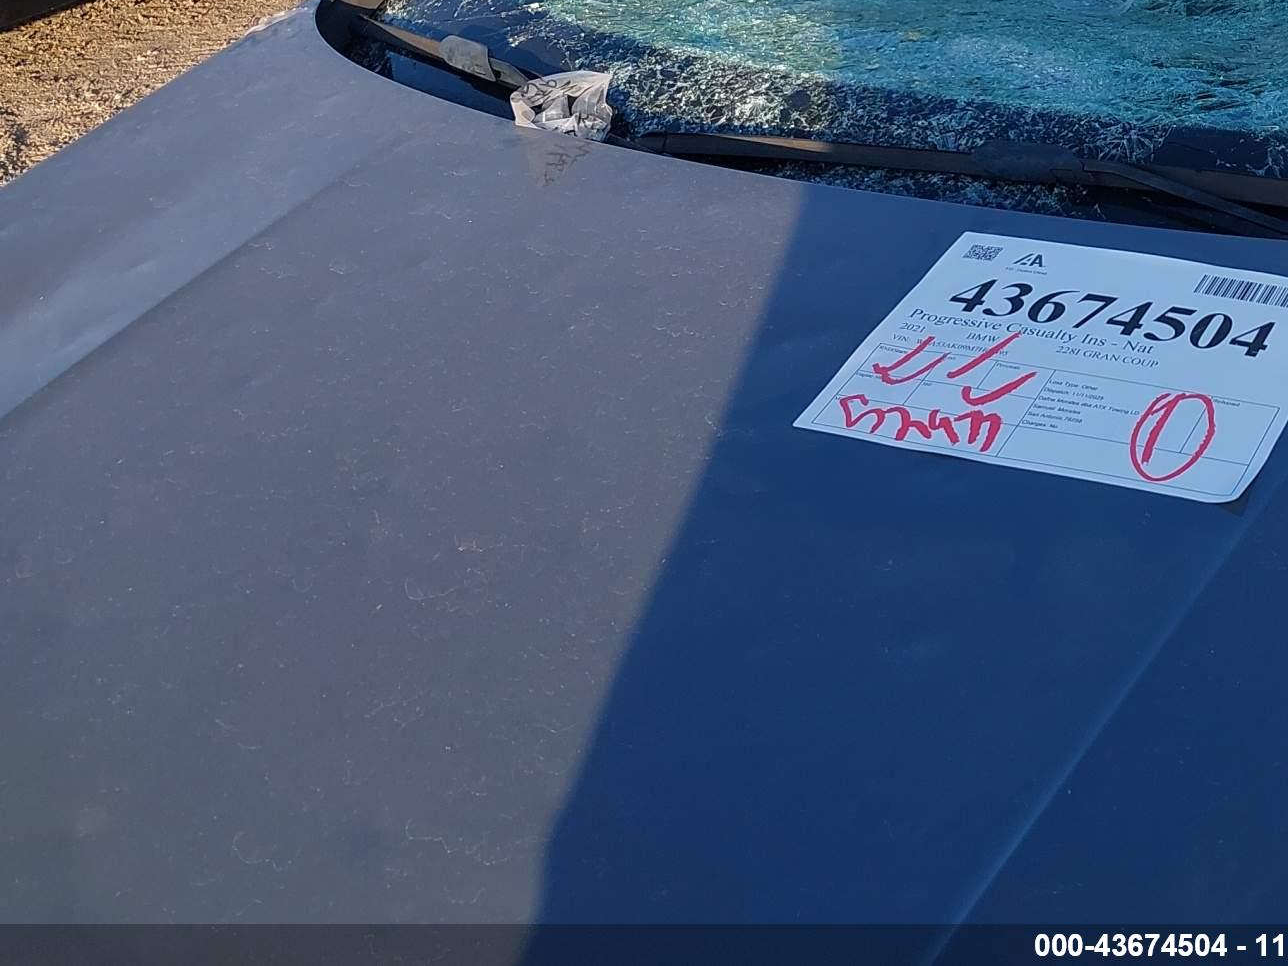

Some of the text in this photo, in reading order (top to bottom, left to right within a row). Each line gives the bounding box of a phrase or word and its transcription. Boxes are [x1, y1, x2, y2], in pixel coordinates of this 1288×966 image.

[909, 308, 1002, 332] Progressive
[1006, 322, 1077, 344] Casualty
[1081, 333, 1107, 347] Ins
[1123, 340, 1154, 354] Nat
[949, 279, 1276, 357] 43674504
[900, 322, 926, 333] 2021
[966, 332, 1000, 342] BMW
[1083, 350, 1121, 362] GRAN
[1122, 356, 1159, 368] COUP
